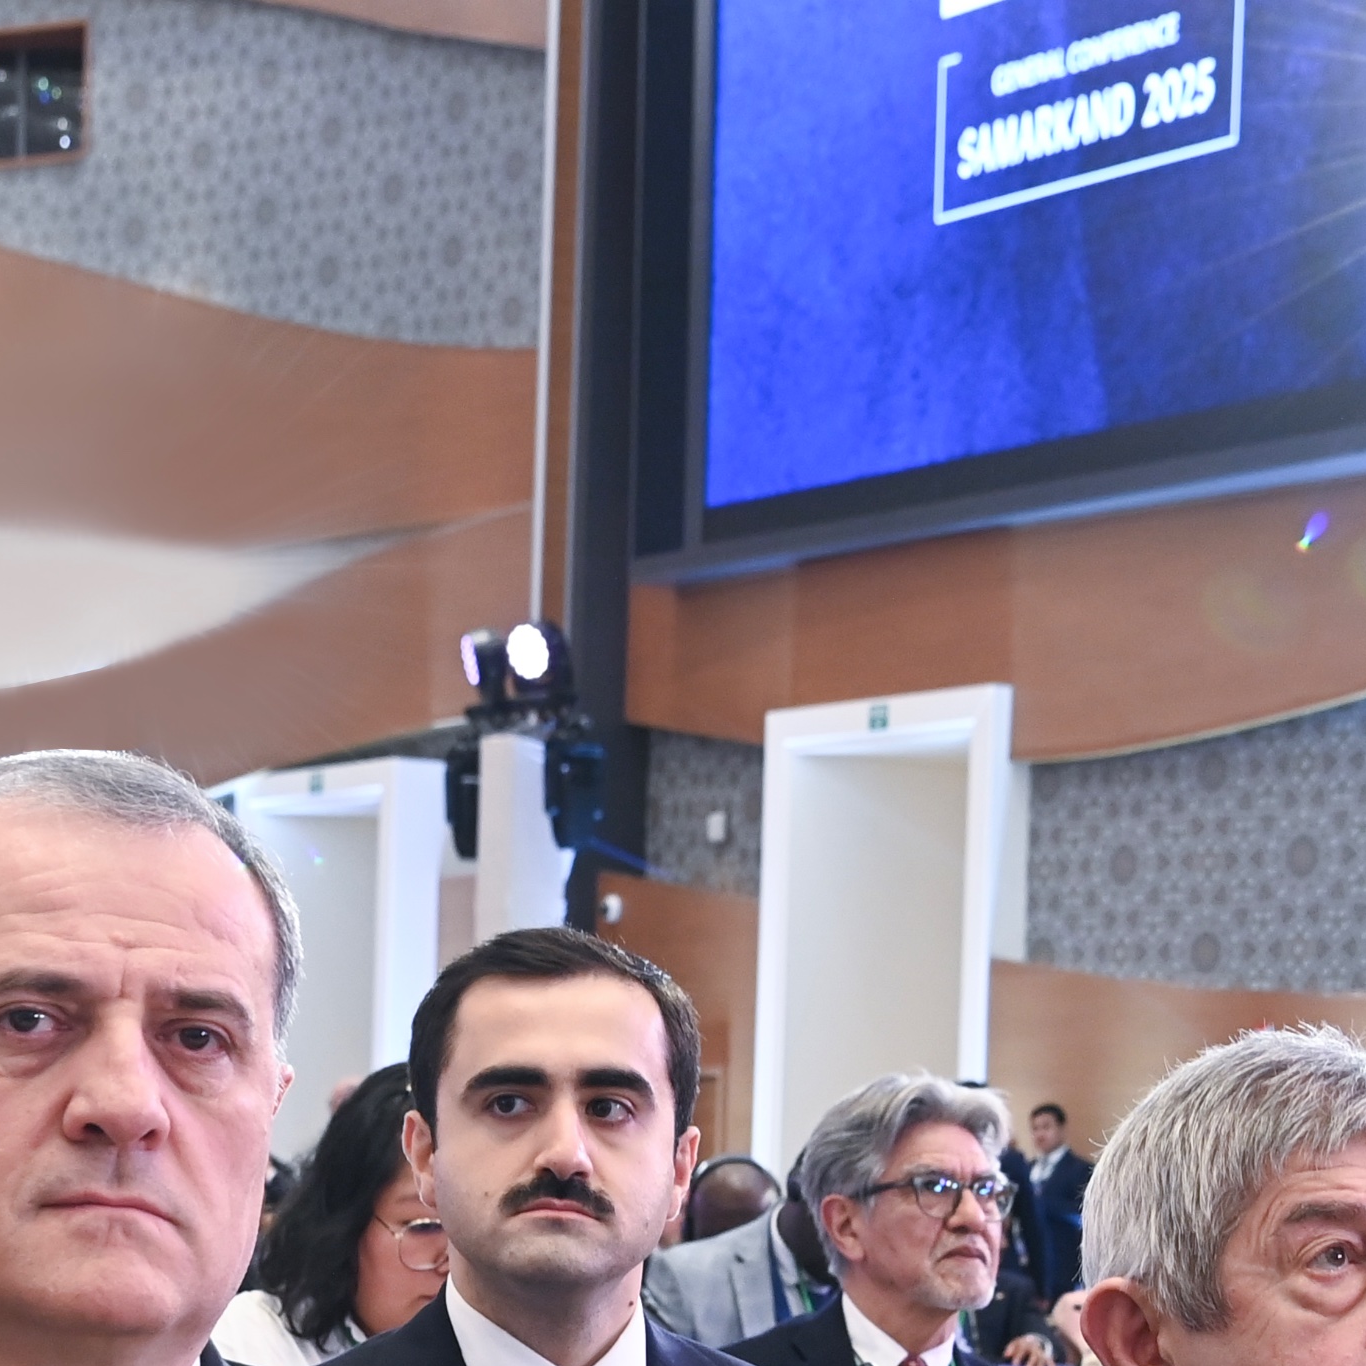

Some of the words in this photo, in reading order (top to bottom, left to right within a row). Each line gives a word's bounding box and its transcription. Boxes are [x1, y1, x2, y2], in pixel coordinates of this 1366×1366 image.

[1066, 11, 1181, 75] CONFERENCE
[957, 82, 1136, 180] SAMARKAND
[1141, 57, 1217, 129] 2025
